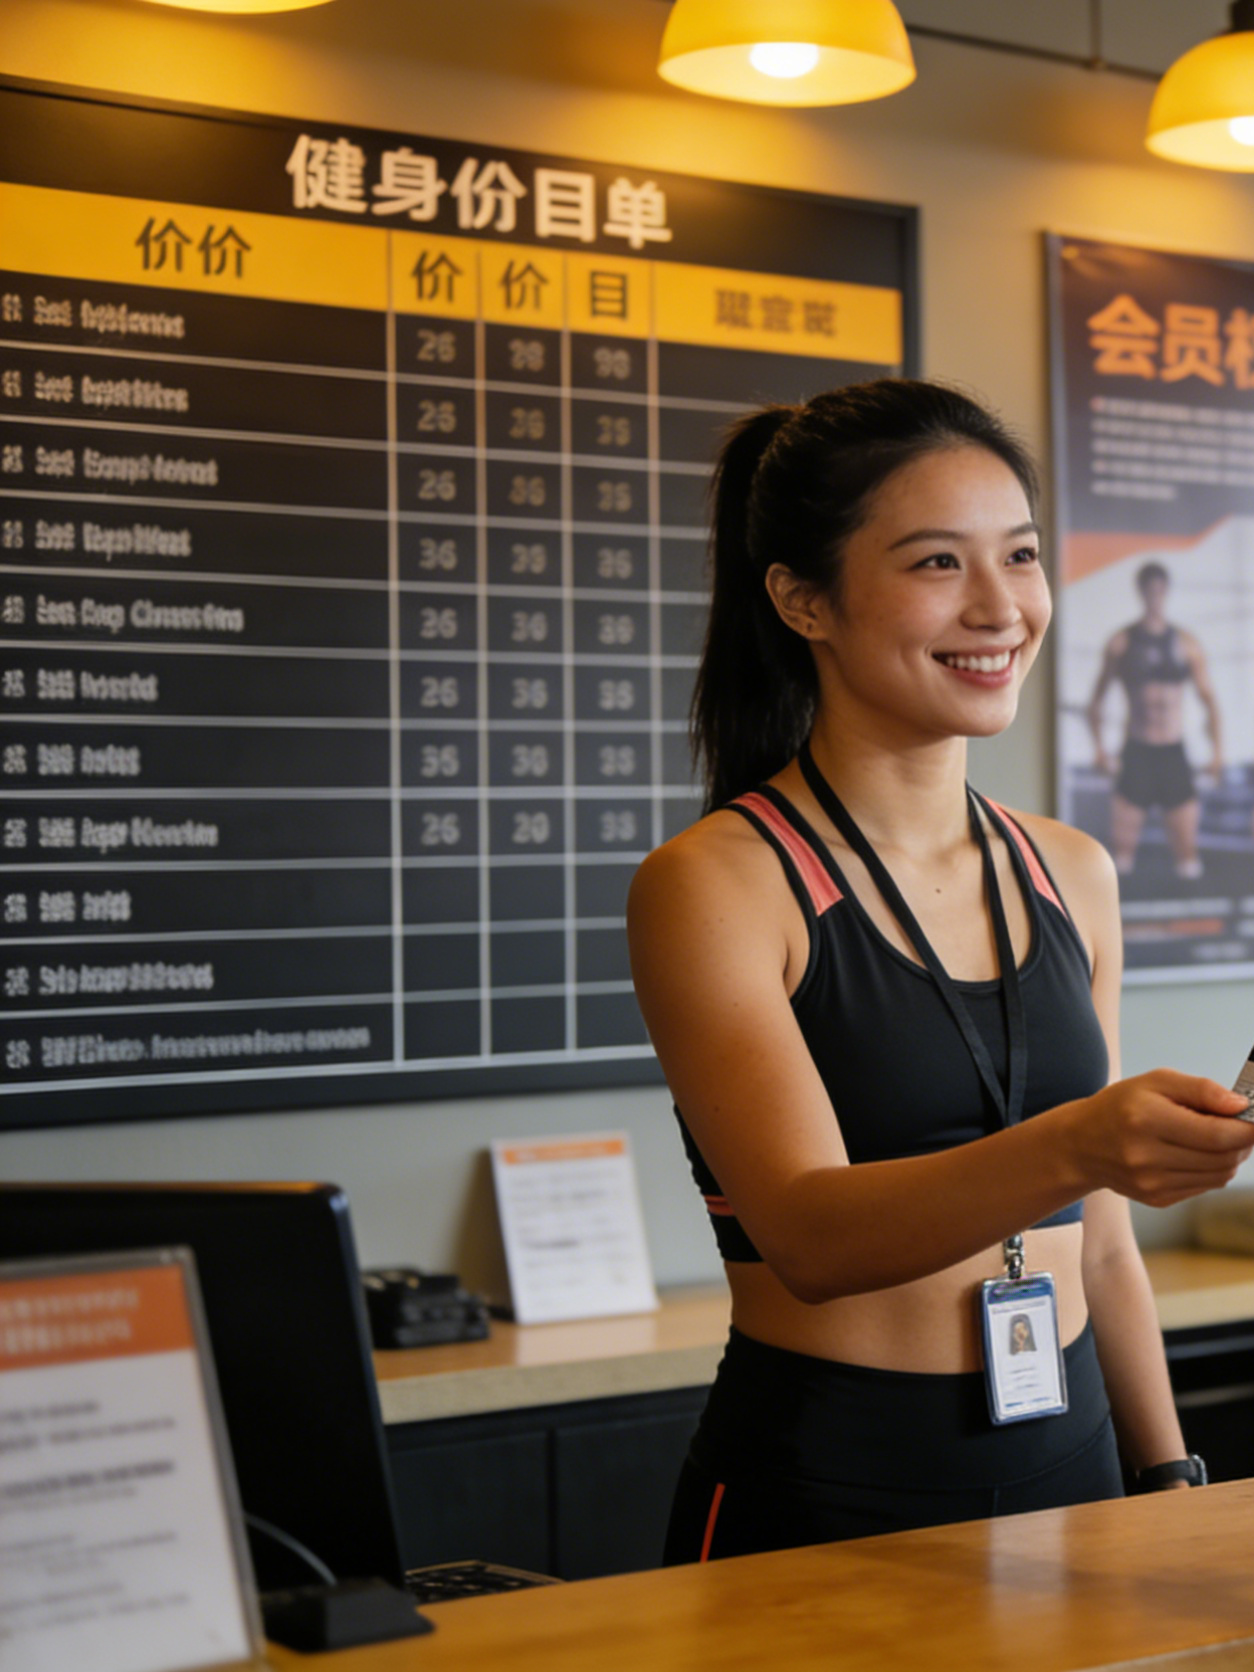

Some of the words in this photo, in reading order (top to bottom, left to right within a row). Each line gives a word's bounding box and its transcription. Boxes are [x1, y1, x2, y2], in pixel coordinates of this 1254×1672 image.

[285, 133, 673, 250] 健身份目单
[134, 215, 253, 279] 价价
[411, 249, 463, 304] 价
[500, 259, 550, 313] 价
[588, 269, 629, 322] 目
[417, 329, 456, 362] 26
[418, 469, 456, 501] 26
